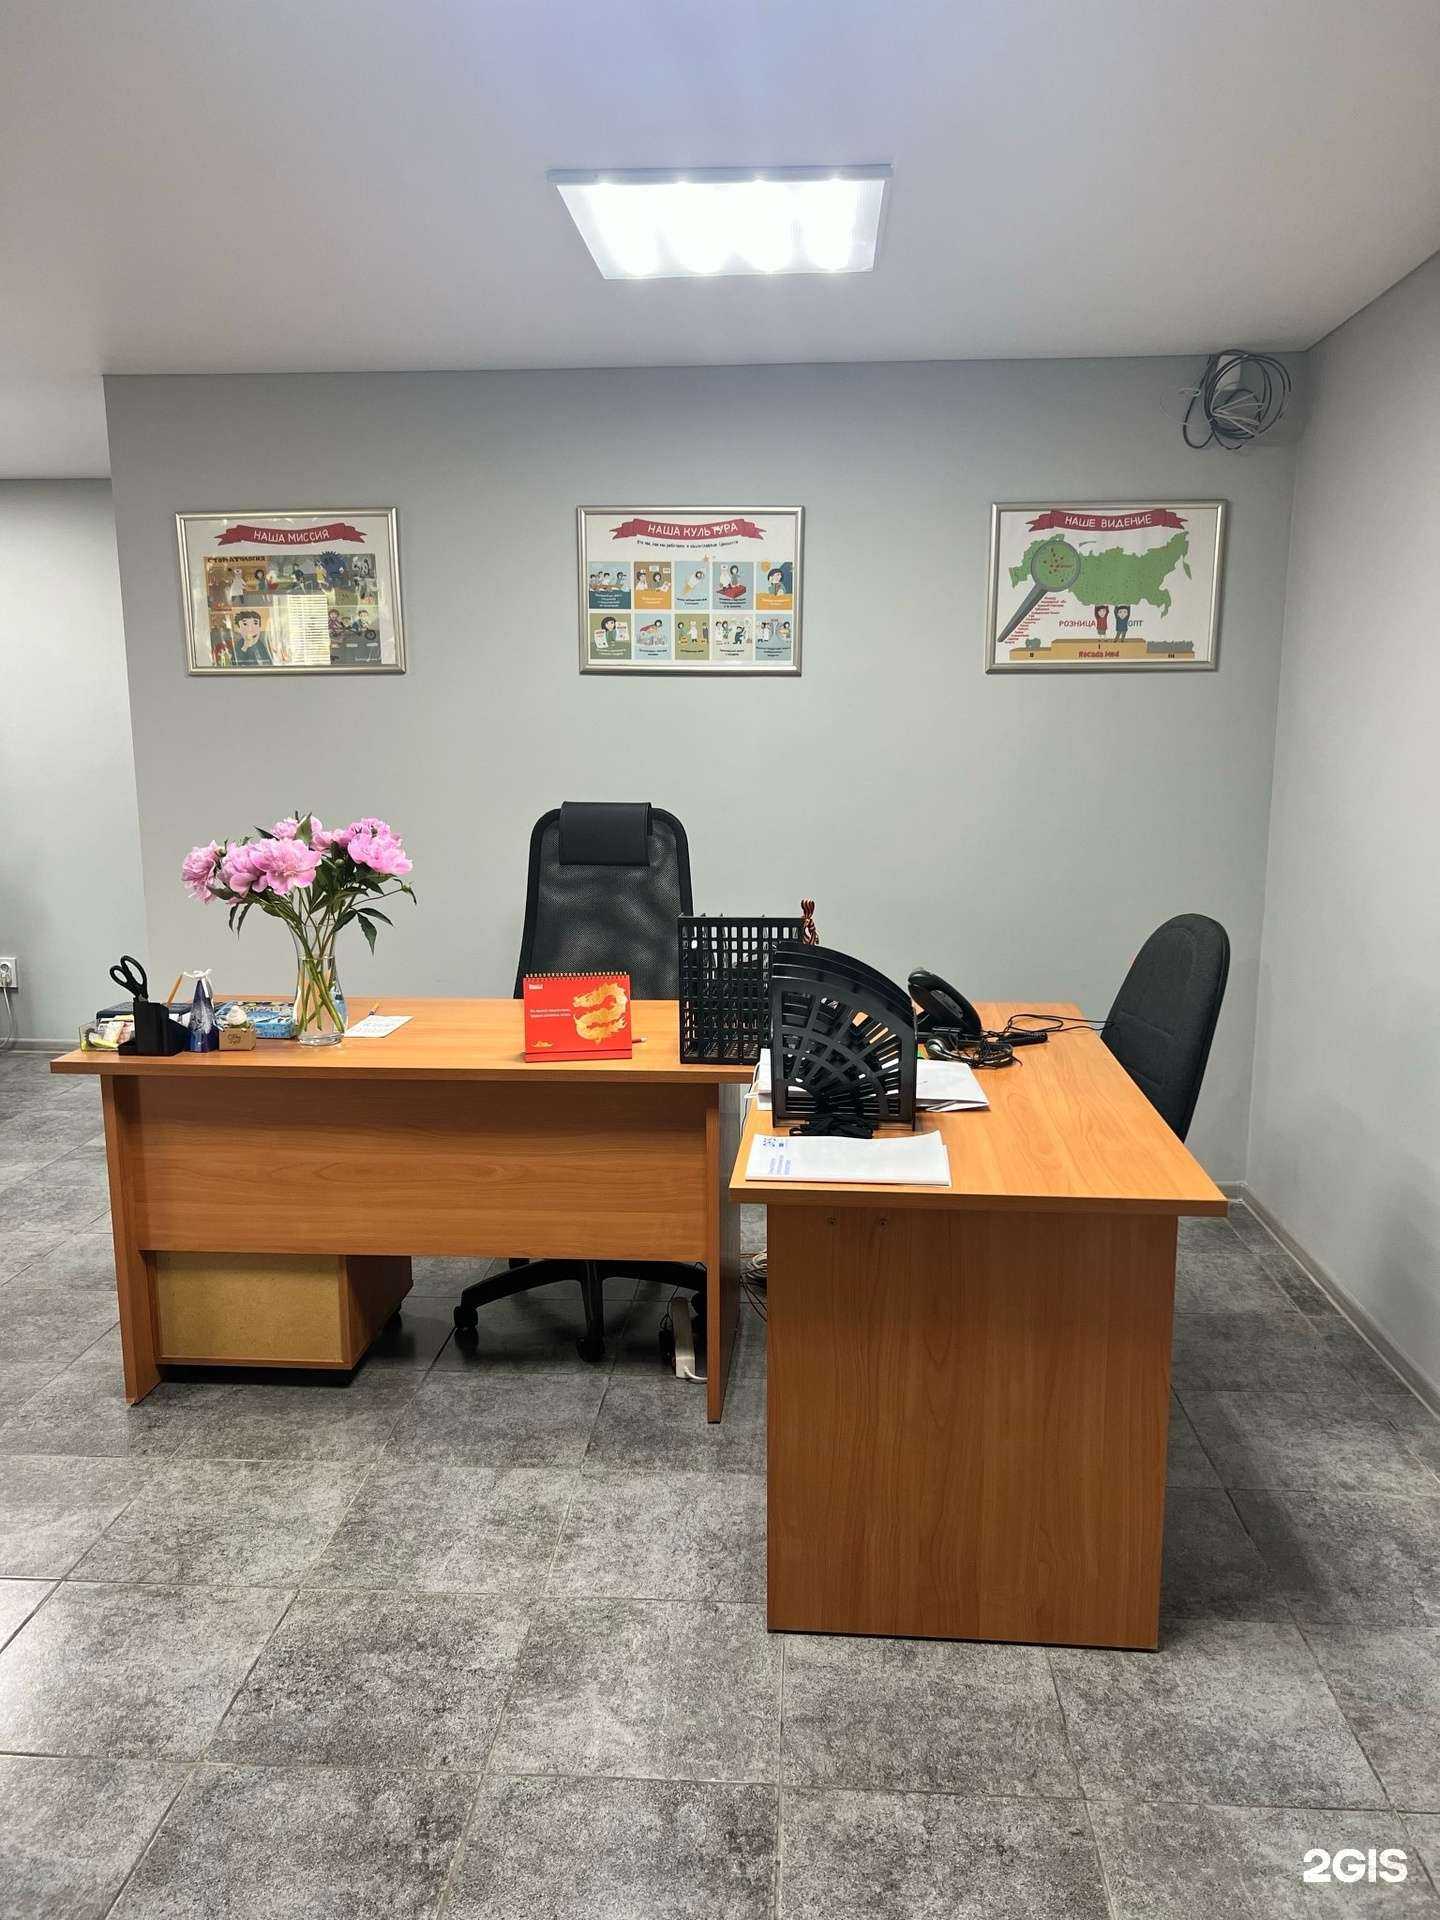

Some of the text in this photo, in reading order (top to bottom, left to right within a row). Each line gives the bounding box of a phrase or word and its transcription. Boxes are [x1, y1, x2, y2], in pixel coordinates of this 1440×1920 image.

[1064, 513, 1152, 528] НАШЕ ВИДЕНИЕ
[253, 528, 330, 543] НАША МИССИЯ
[647, 522, 738, 537] НАША КУЛЬТУРА
[1058, 619, 1096, 628] РОЗНИЦА
[1127, 619, 1144, 628] ОПТ
